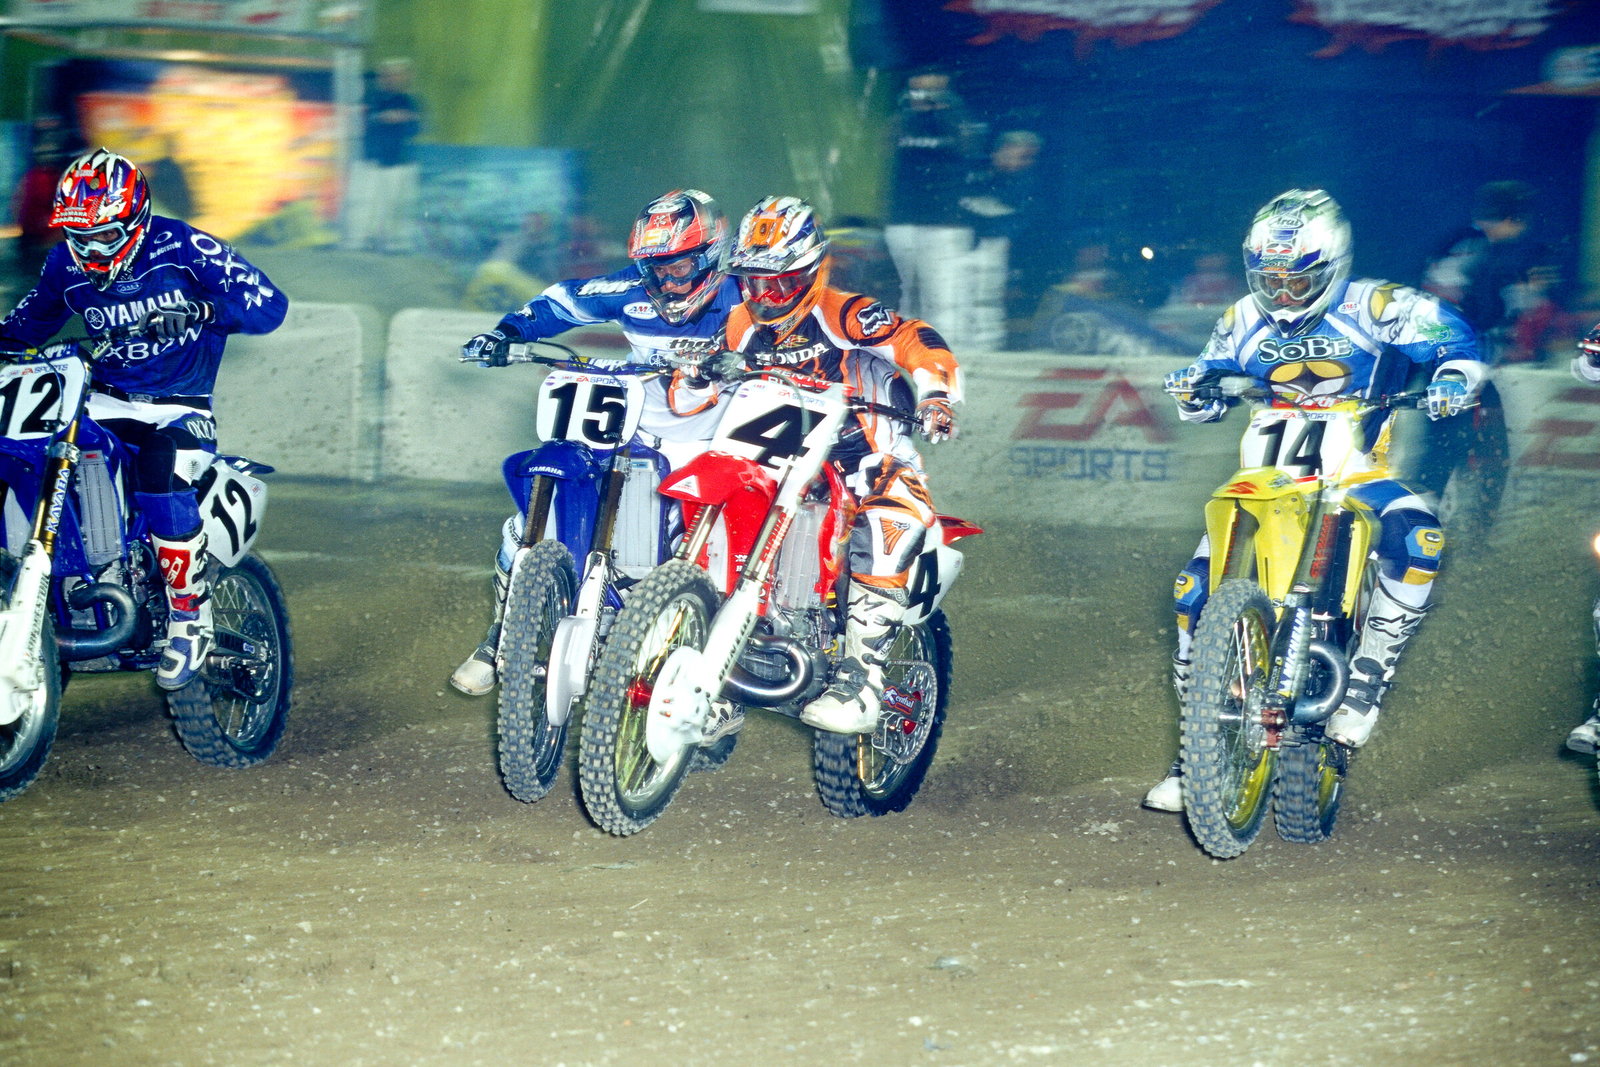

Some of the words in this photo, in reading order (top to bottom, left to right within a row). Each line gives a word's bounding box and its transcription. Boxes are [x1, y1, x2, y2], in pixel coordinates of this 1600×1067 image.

[103, 288, 187, 327] YAMAHA
[576, 375, 590, 383] EA
[589, 376, 629, 387] SPORTS
[755, 342, 830, 366] HONDA
[0, 372, 67, 437] 12
[548, 382, 630, 445] 15
[1009, 367, 1176, 443] EA
[726, 404, 828, 470] 4
[1008, 446, 1171, 482] SPORTS
[1257, 419, 1329, 477] 14
[45, 468, 70, 534] KAYABA
[528, 466, 564, 476] YAMAHA
[210, 478, 259, 558] 12
[905, 548, 942, 619] 4
[1283, 607, 1306, 680] MICHELIN
